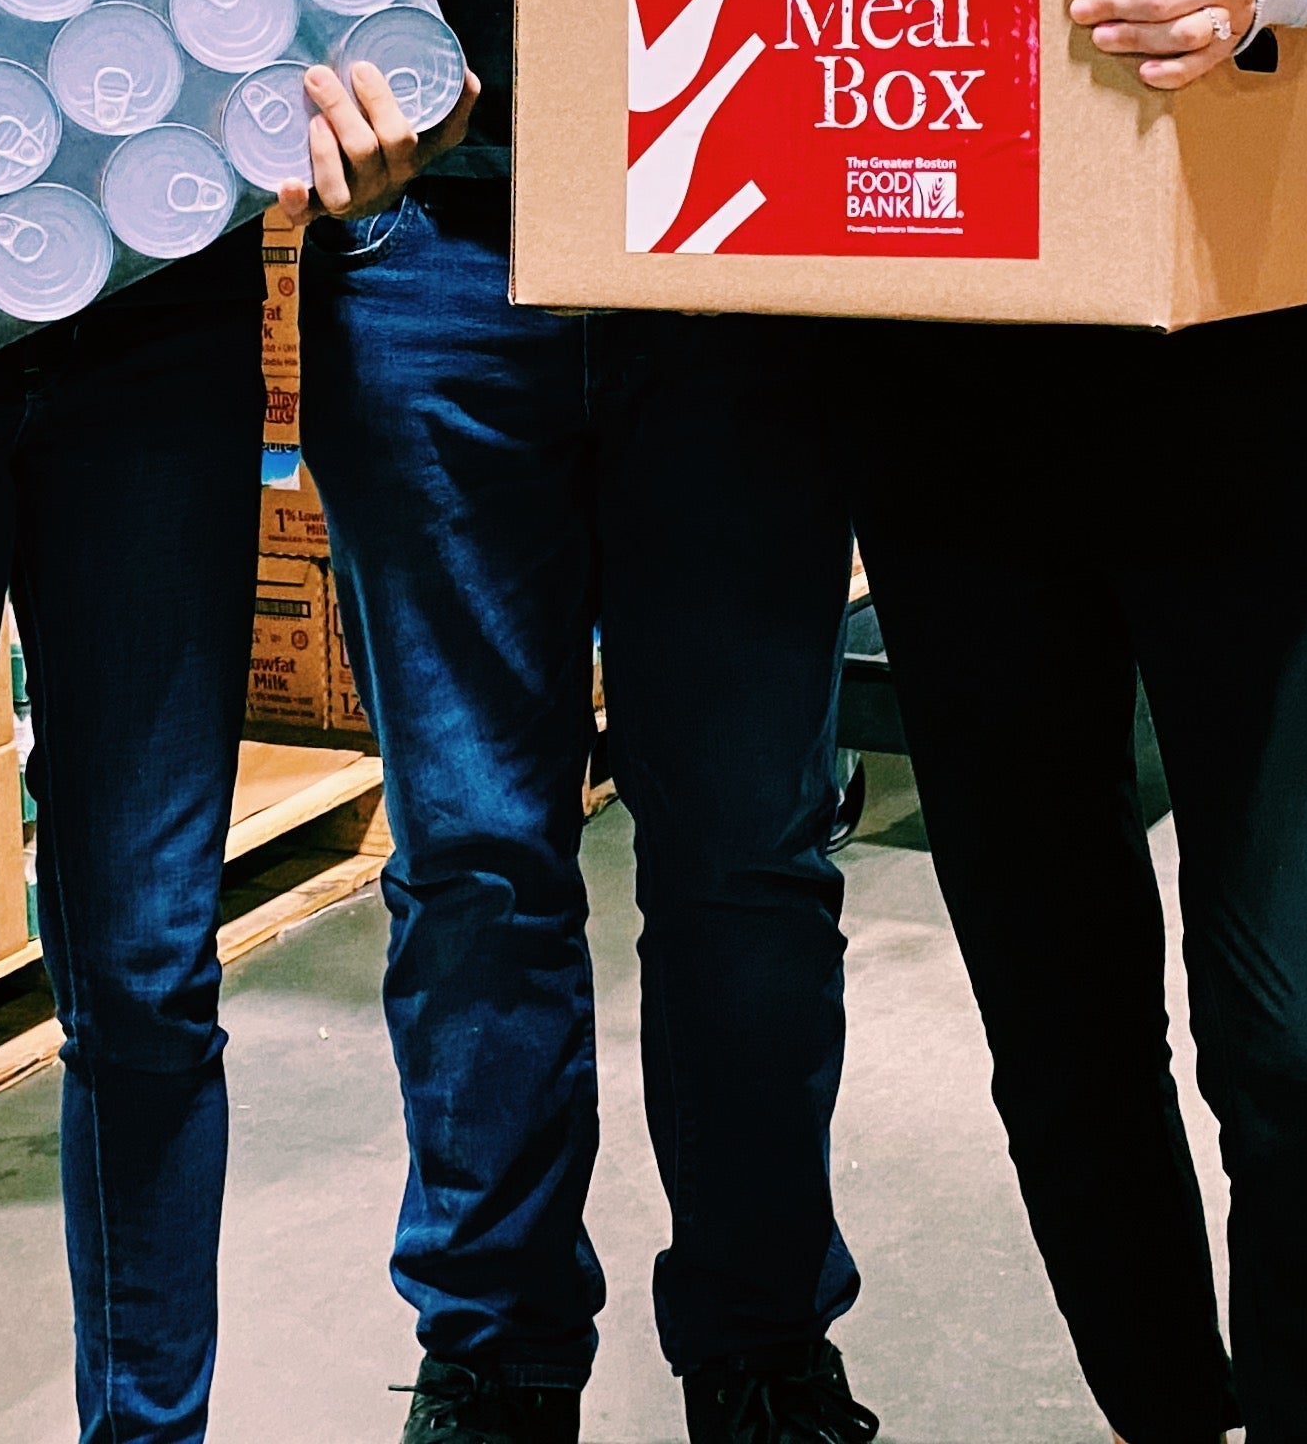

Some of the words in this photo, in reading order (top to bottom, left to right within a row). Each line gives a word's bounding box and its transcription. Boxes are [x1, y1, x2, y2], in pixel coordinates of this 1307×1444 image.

[814, 56, 985, 130] Box
[846, 157, 868, 169] The
[870, 157, 914, 169] Greater
[915, 157, 956, 169] Boston
[847, 171, 911, 193] FOOD
[847, 196, 911, 218] BANK
[254, 673, 289, 692] Milk
